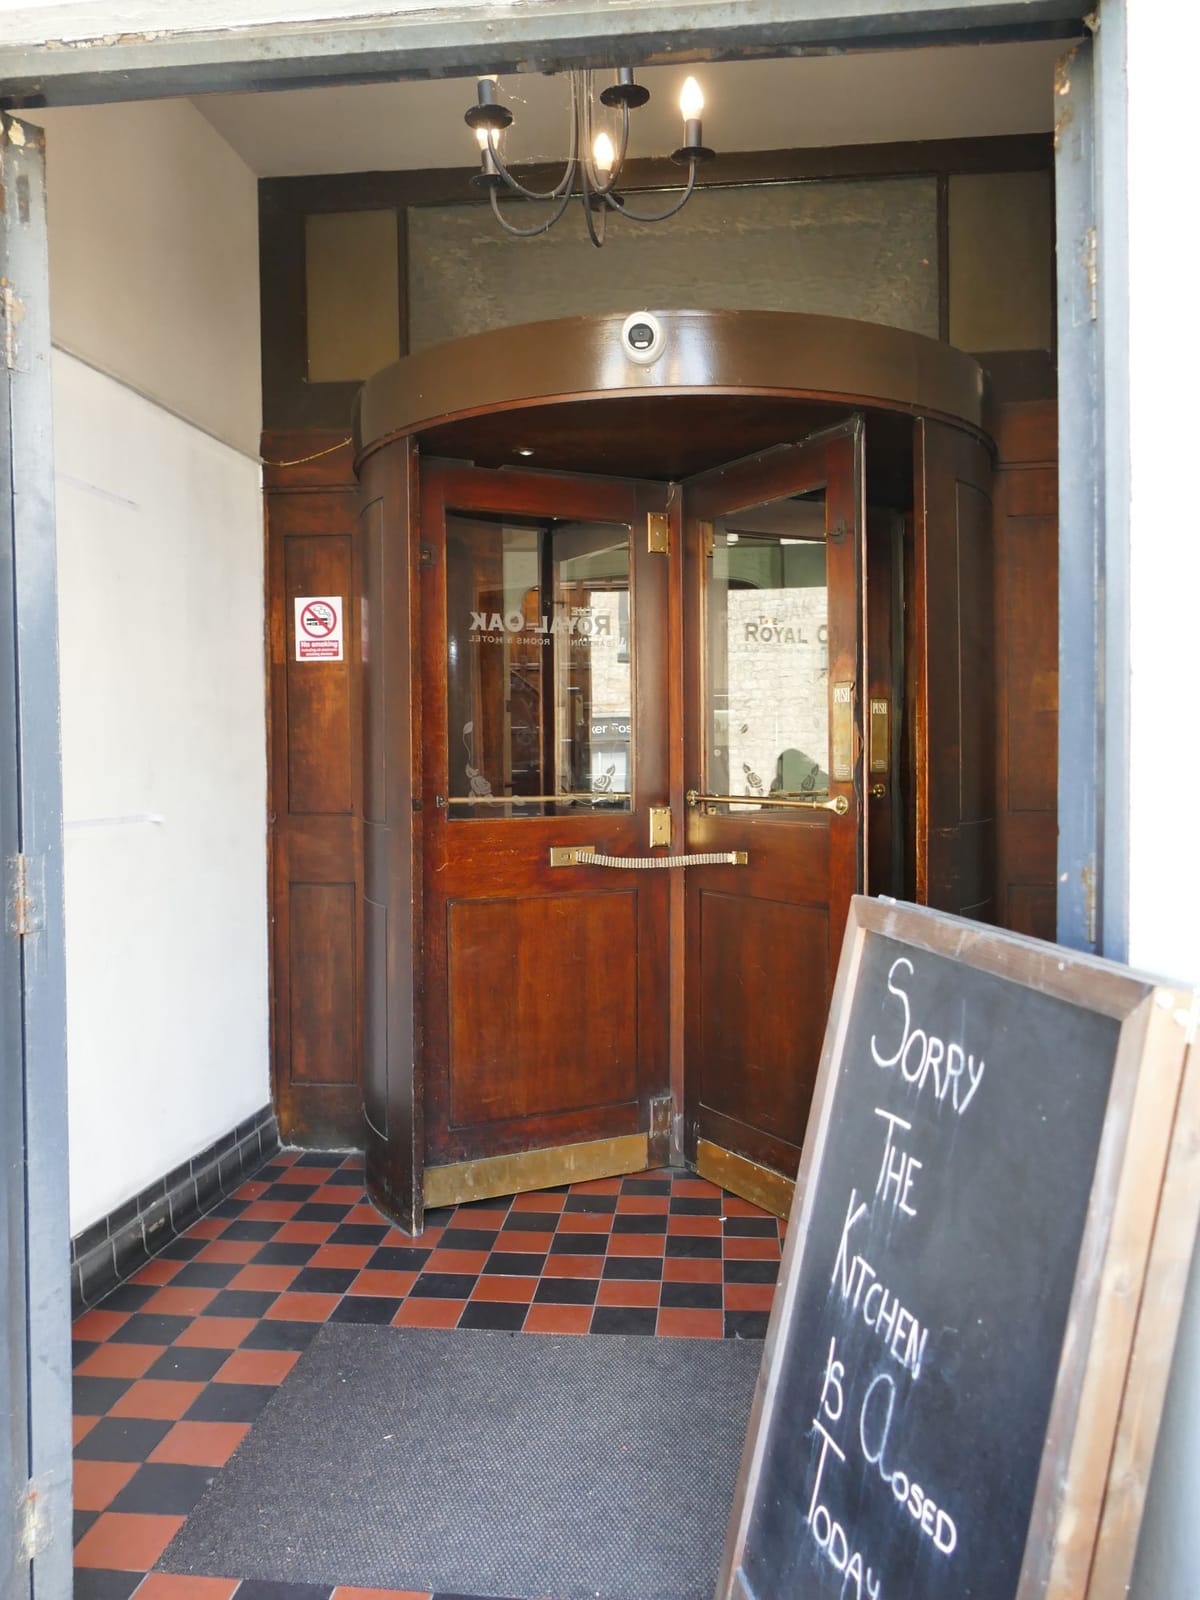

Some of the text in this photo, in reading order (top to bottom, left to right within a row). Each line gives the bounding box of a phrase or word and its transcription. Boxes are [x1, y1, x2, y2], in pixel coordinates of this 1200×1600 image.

[743, 622, 809, 644] ROYAL
[758, 615, 778, 626] TE
[872, 702, 888, 714] PUSH
[871, 957, 985, 1115] SORRY
[874, 1107, 923, 1217] THE
[831, 1188, 929, 1380] KITCHEN
[807, 1418, 880, 1600] TODAY
[820, 1336, 957, 1555] IS CLOSED
